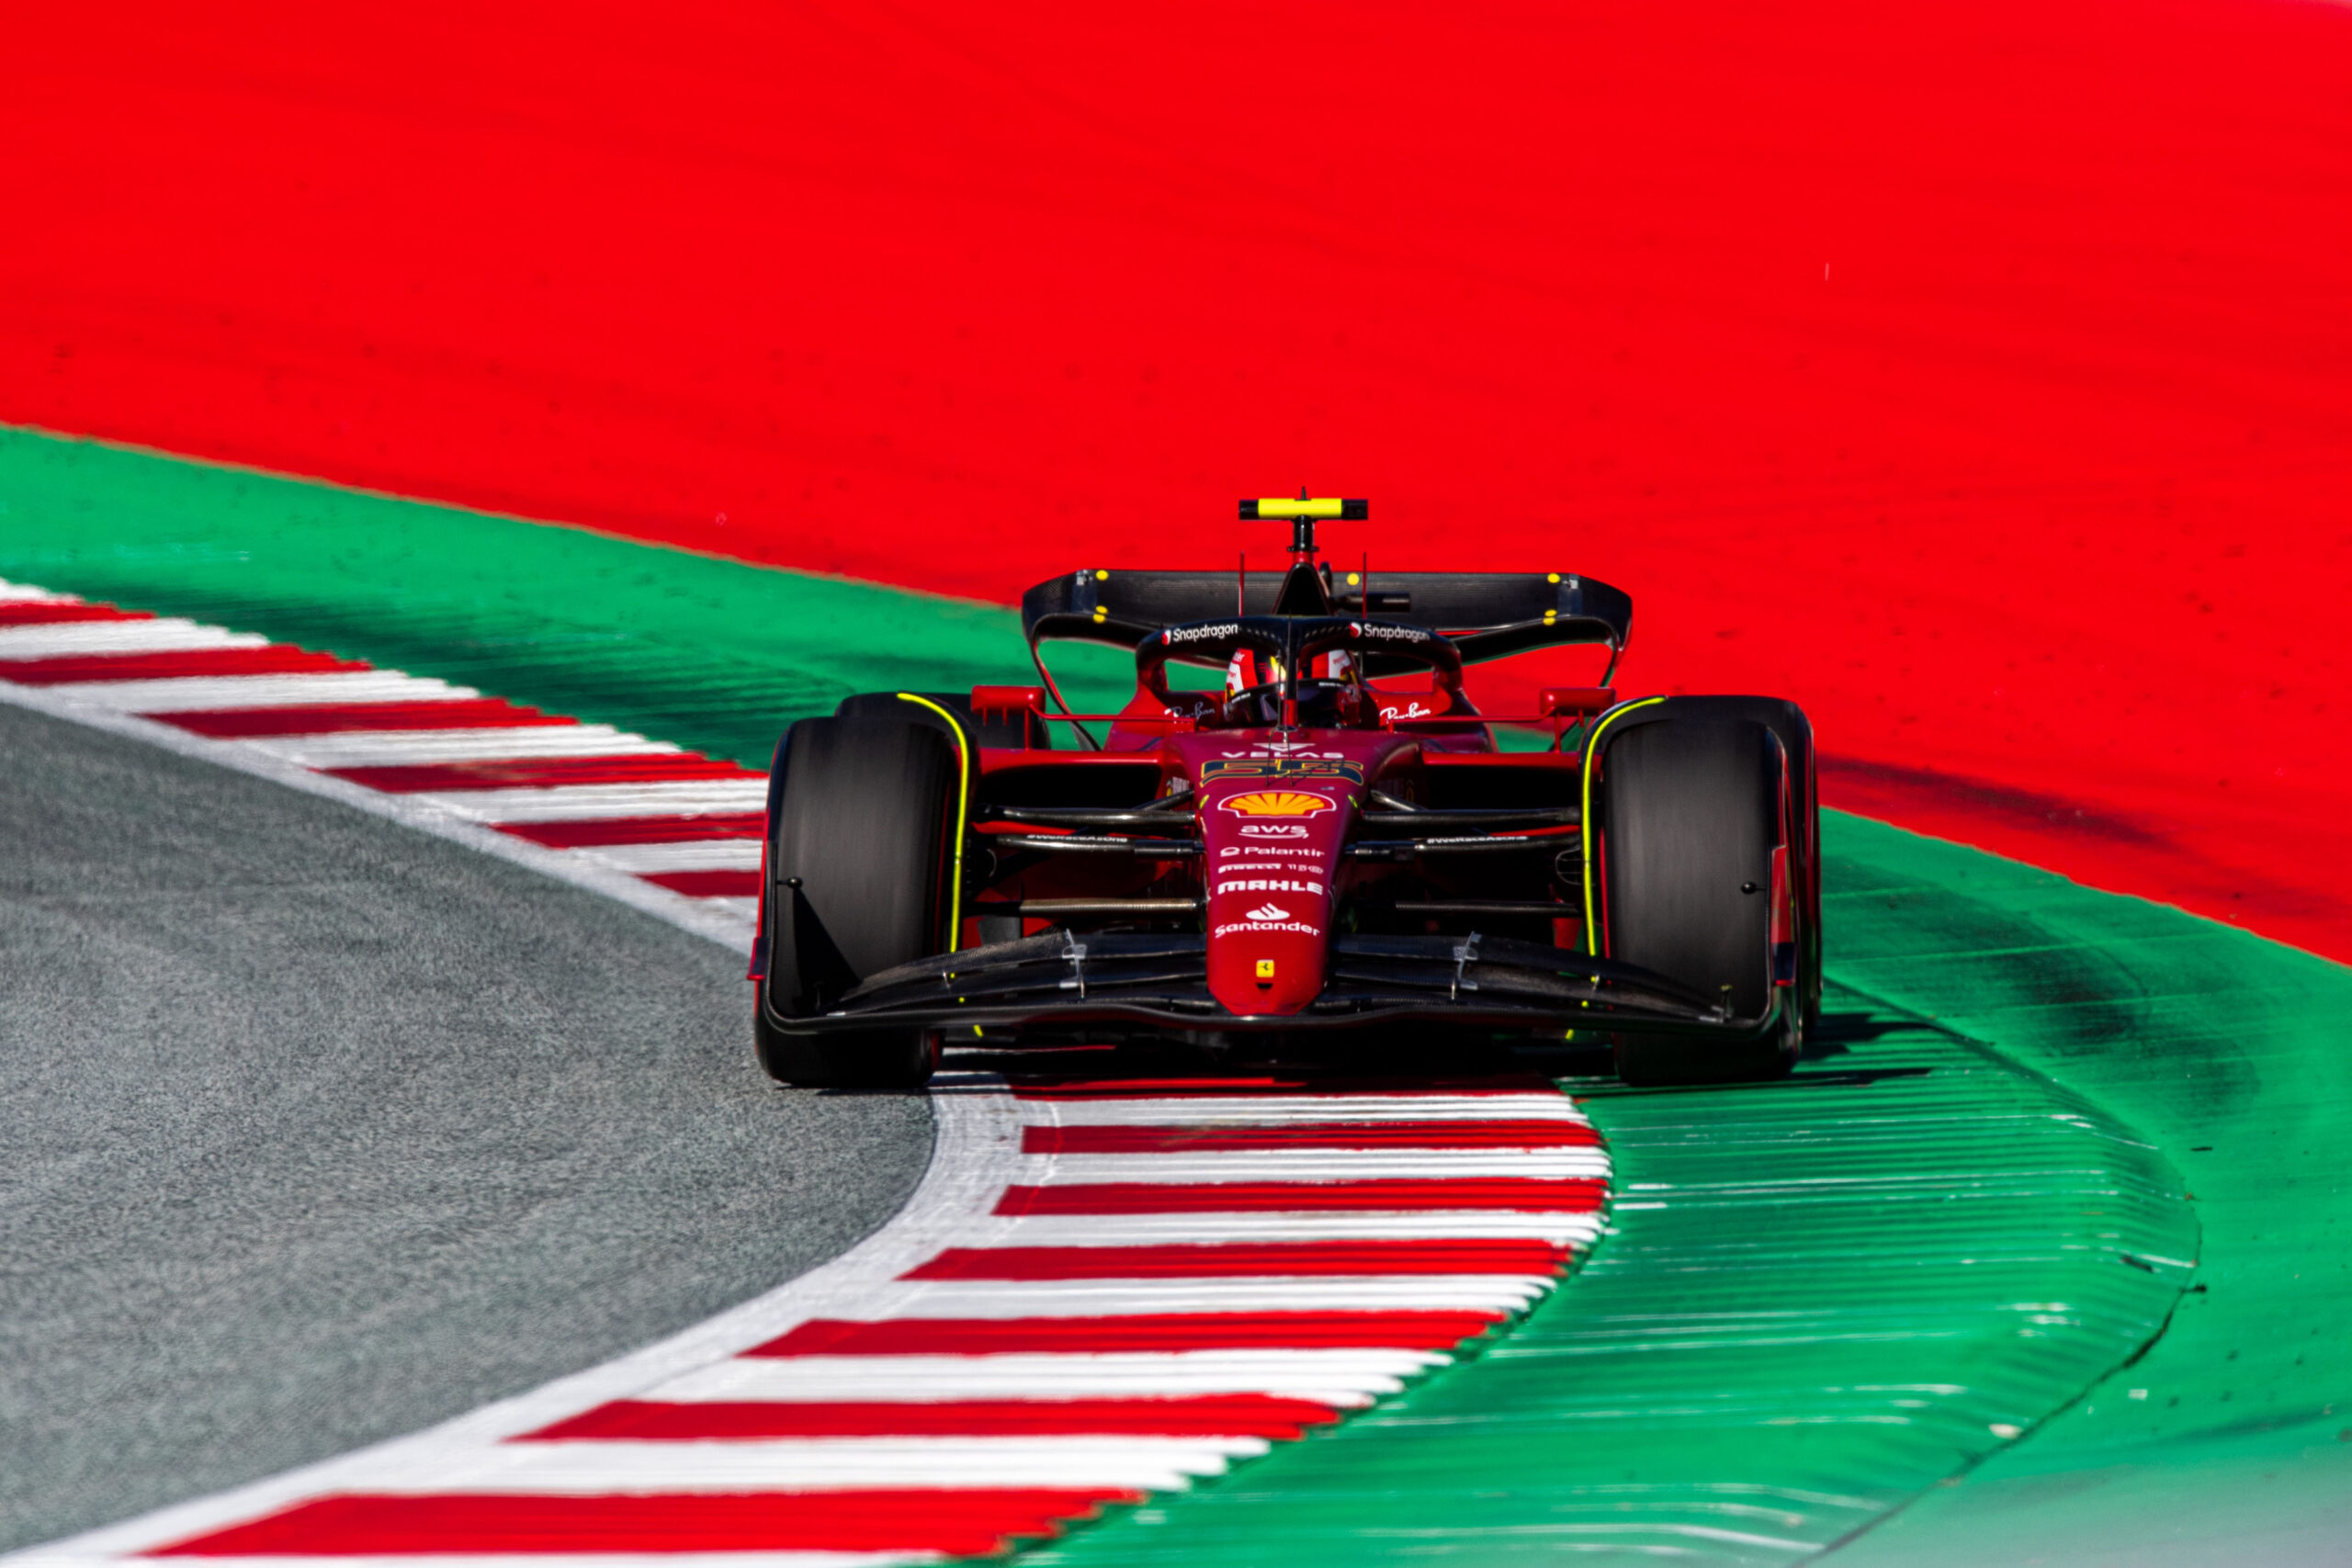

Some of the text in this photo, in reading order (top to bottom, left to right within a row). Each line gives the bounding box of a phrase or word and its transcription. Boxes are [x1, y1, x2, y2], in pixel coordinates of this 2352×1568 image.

[1173, 624, 1238, 642] Snapdragon
[1364, 623, 1430, 643] Snapdragon
[1240, 825, 1307, 835] aws
[1244, 847, 1325, 857] Palantir
[1217, 880, 1323, 896] MAHLE
[1215, 921, 1320, 939] Santander
